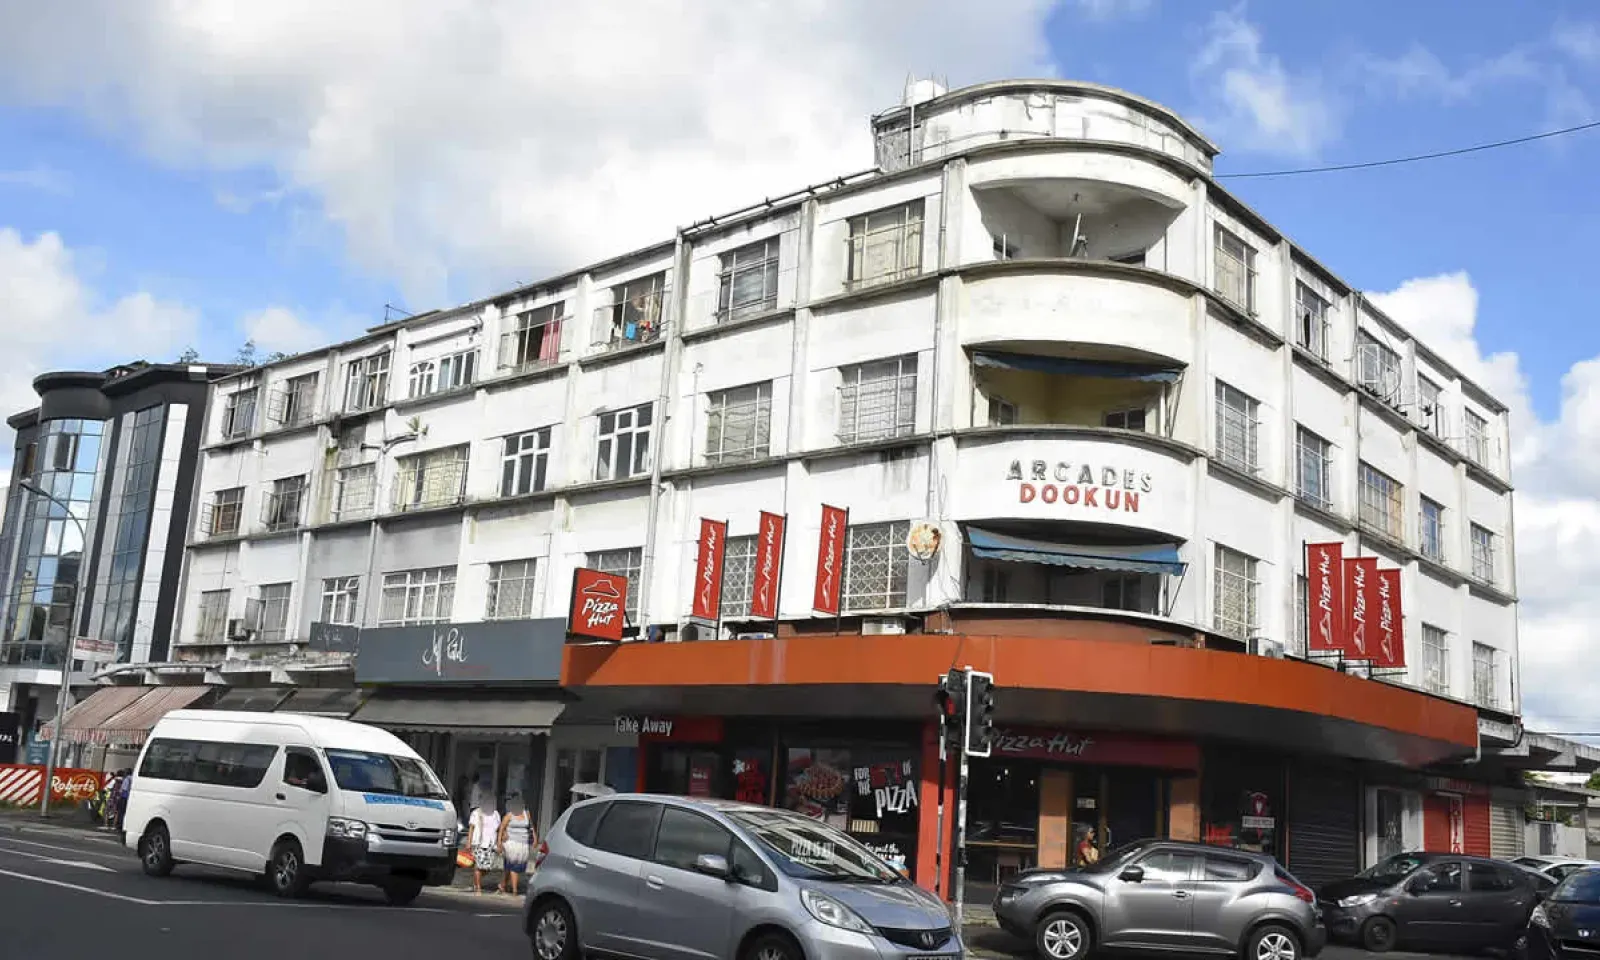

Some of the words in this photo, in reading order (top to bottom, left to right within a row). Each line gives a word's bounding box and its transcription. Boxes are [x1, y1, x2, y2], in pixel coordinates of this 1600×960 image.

[1006, 458, 1153, 493] ARCADES
[1020, 483, 1140, 512] DOOKUN
[707, 524, 717, 550] Hut
[766, 518, 775, 544] Hut
[828, 511, 837, 539] Hut
[703, 551, 714, 585] Pizza
[762, 545, 772, 580] Pizza
[824, 539, 834, 576] Pizza
[1318, 547, 1330, 575] Hut
[1354, 562, 1366, 588] Hut
[1379, 573, 1390, 598] Hut
[581, 598, 619, 616] Pizza
[1319, 576, 1332, 611] Pizza
[1353, 589, 1366, 623] Pizza
[587, 613, 616, 629] Hut
[1380, 599, 1393, 632] Pizza
[615, 716, 639, 733] Take
[641, 716, 673, 737] Away
[1045, 732, 1094, 756] Hut
[874, 779, 918, 818] PIZZA
